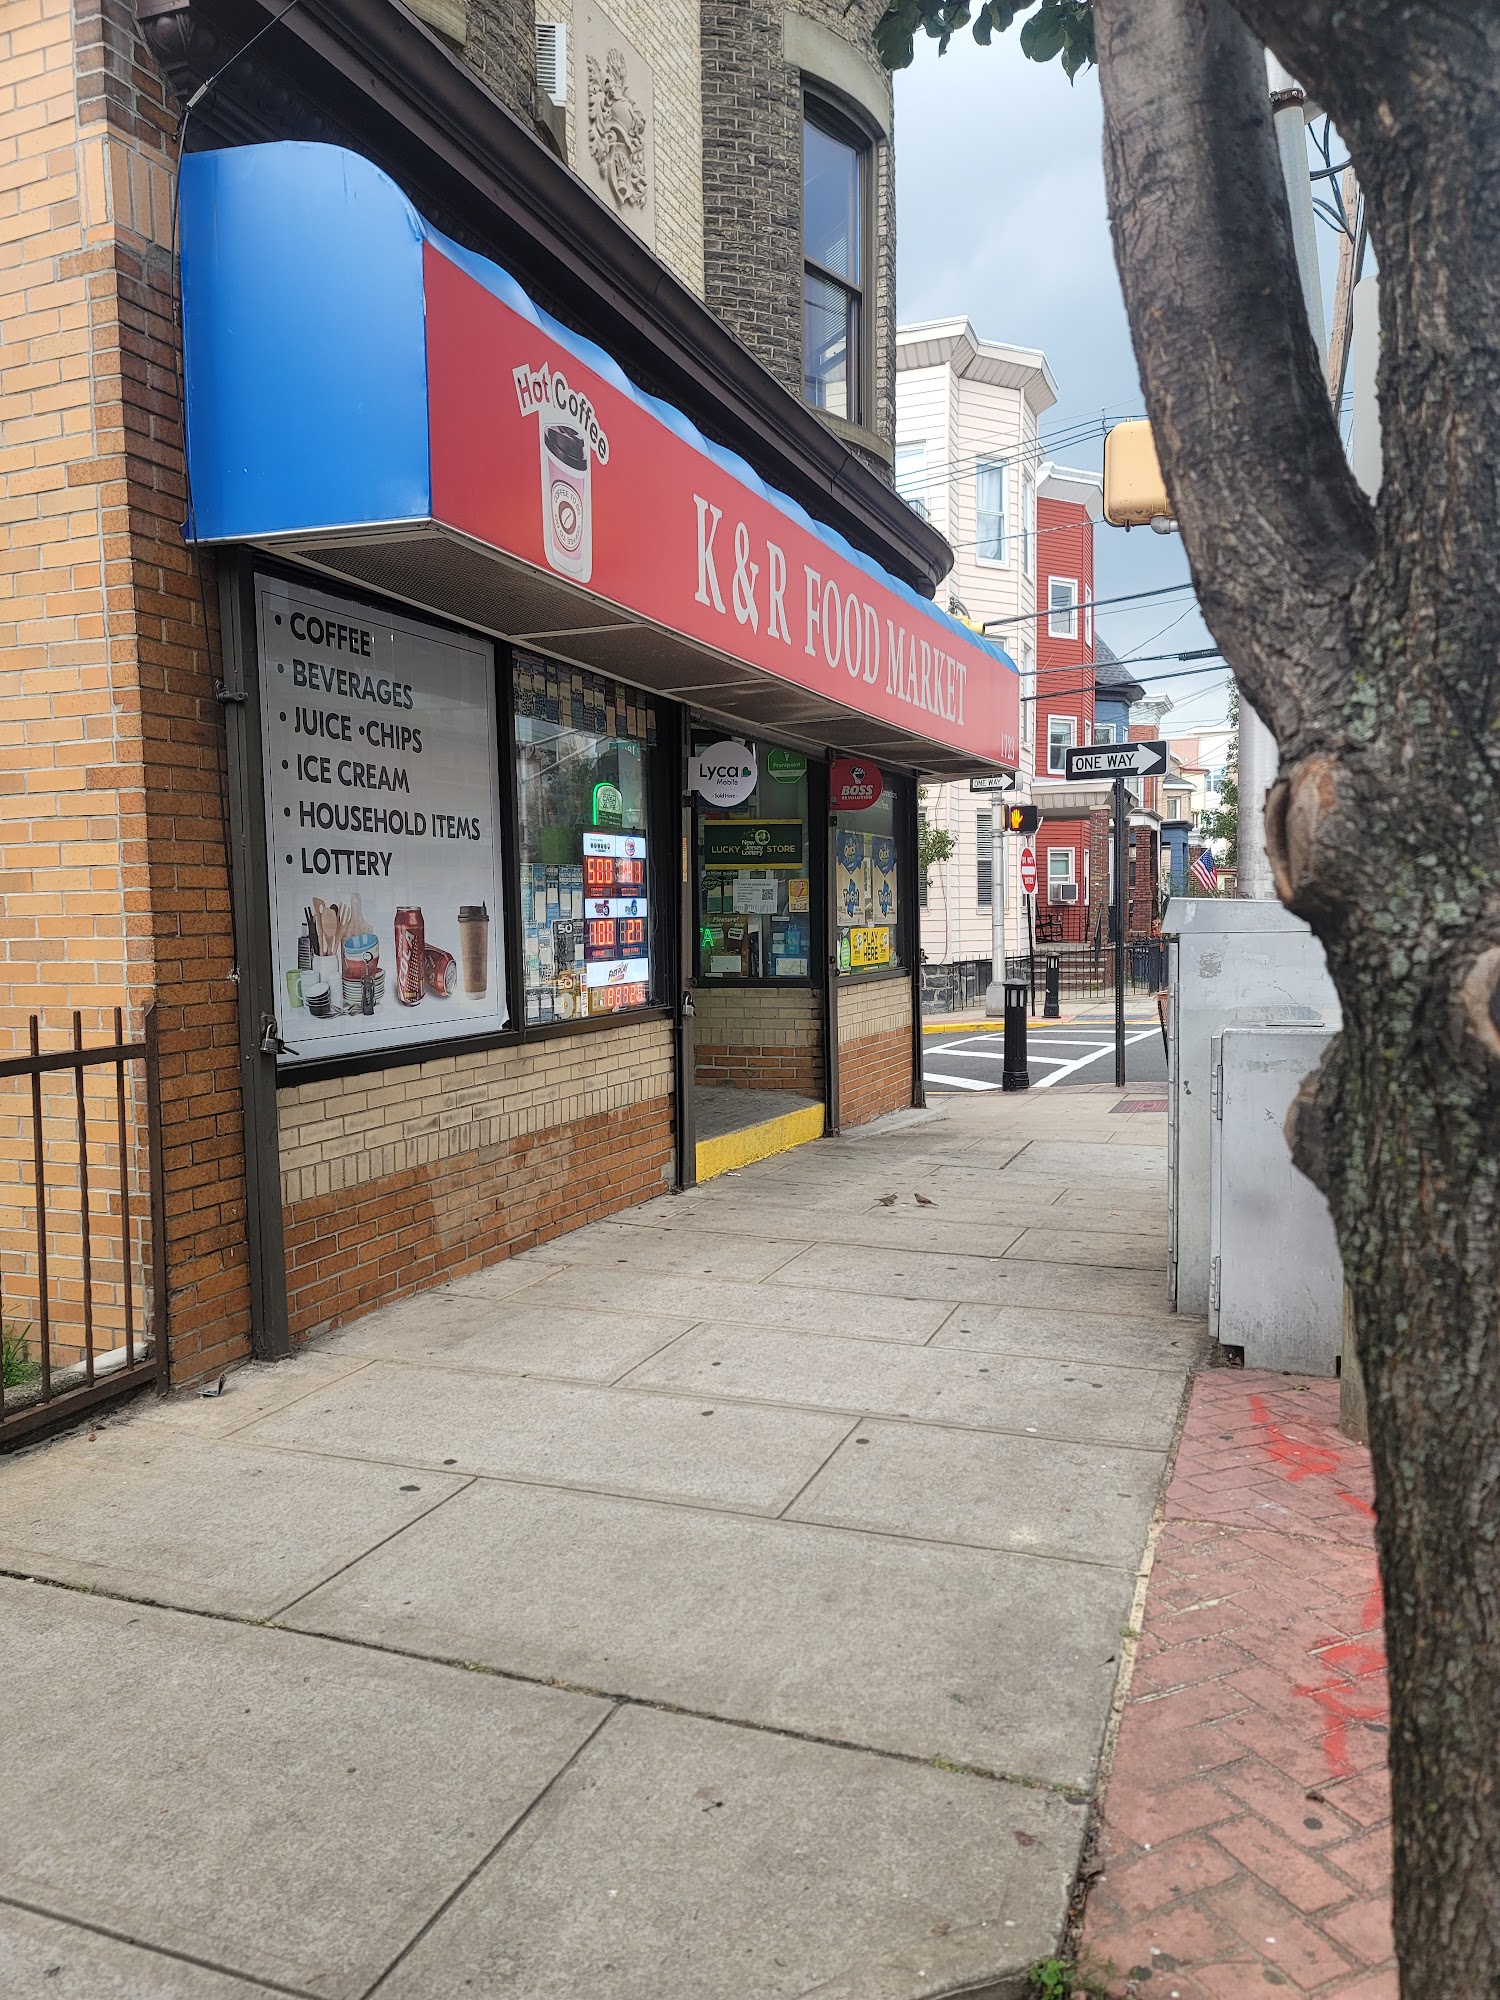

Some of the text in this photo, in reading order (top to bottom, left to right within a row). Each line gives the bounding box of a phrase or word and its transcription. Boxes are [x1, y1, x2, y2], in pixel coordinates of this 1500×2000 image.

[517, 369, 606, 459] Hot Coffee
[554, 489, 569, 503] COFFEE
[290, 612, 371, 657] COFFEE
[804, 564, 880, 684] FOOD
[885, 618, 967, 726] MARKET
[293, 659, 413, 709] BEVERAGES
[295, 707, 351, 741] JUICE
[1001, 732, 1015, 761] 1723
[297, 754, 410, 793] ICE CREAM
[699, 763, 738, 780] Lyca
[1075, 753, 1135, 771] ONE WAY
[841, 785, 873, 795] BOSS
[974, 778, 1001, 787] ONE WAY
[299, 801, 480, 841] HOUSEHOLD ITEMS
[766, 845, 796, 853] STORE
[301, 847, 392, 876] LOTTERY
[604, 900, 609, 916] 5
[863, 931, 878, 946] PLAY
[863, 946, 878, 962] HERE
